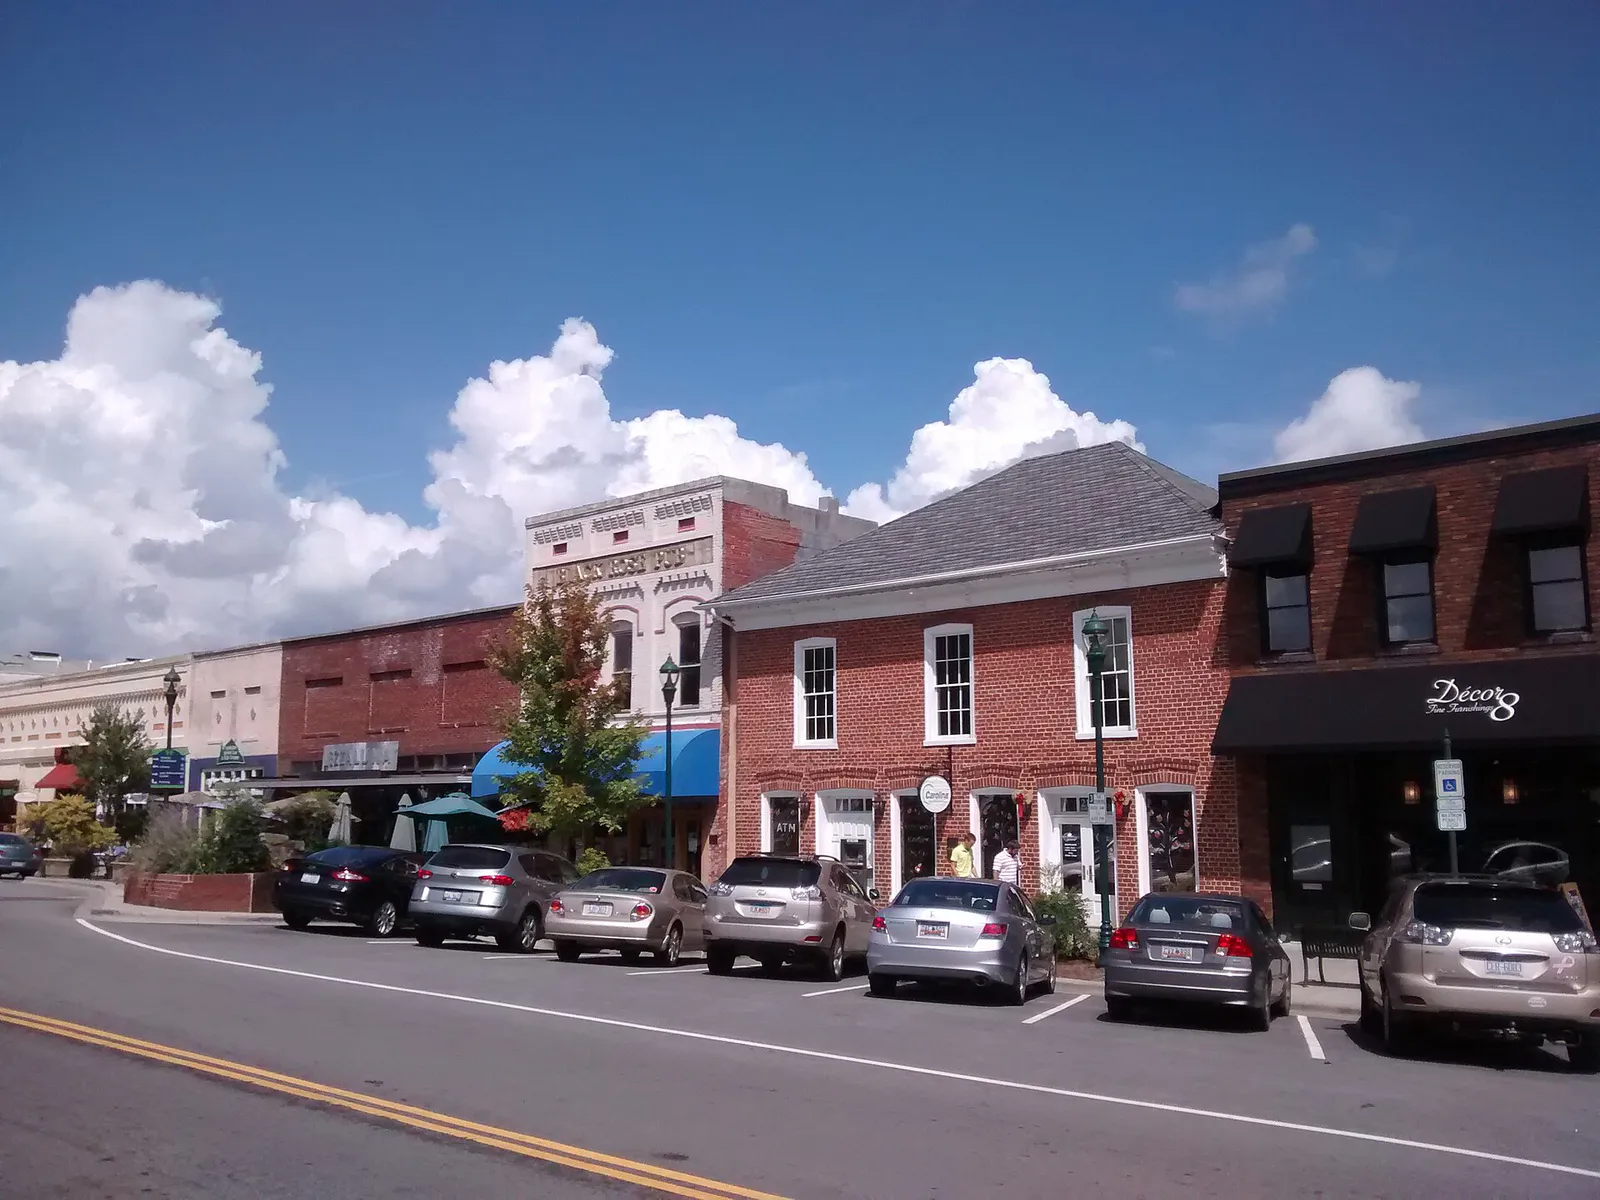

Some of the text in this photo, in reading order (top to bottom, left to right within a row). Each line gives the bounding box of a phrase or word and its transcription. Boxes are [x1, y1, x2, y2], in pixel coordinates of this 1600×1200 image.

[1427, 679, 1519, 721] Décor 8
[1426, 702, 1494, 714] Fine Furnishings
[926, 791, 949, 799] Carolina
[776, 823, 796, 833] ATM
